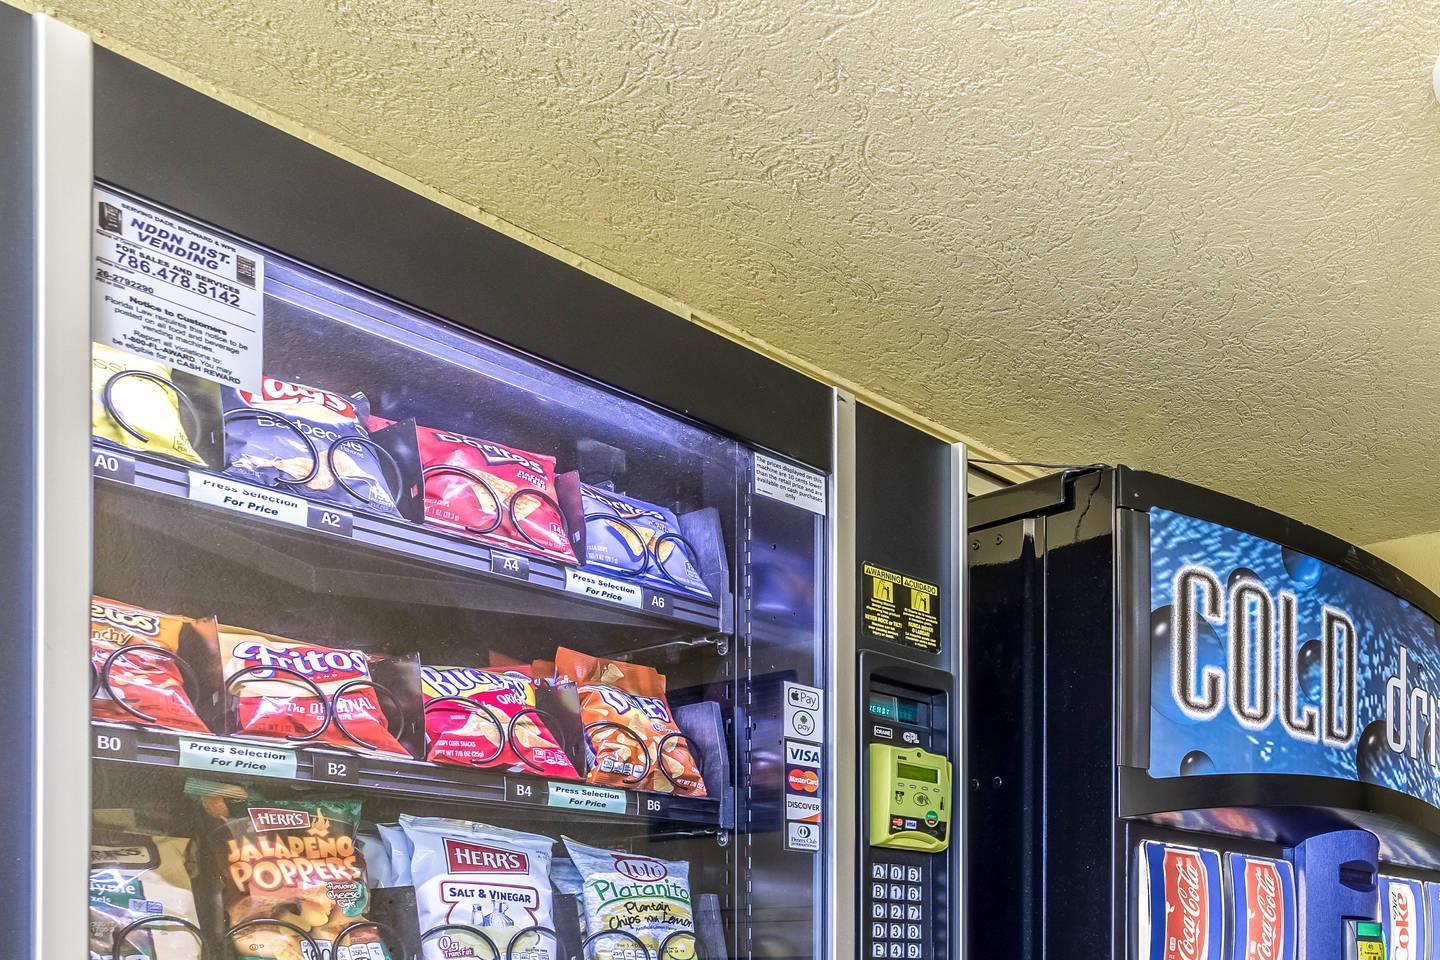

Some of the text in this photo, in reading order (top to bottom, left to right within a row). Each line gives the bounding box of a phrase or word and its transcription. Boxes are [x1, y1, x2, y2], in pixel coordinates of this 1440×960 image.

[130, 218, 184, 246] NDDN
[188, 241, 231, 265] DIST.
[138, 231, 218, 270] VENDING
[115, 243, 240, 294] FOR SALES AND SERVICES
[115, 250, 240, 307] 786.478.5142
[105, 295, 134, 311] Florida
[136, 307, 153, 316] Law
[155, 313, 188, 330] requires
[189, 325, 202, 335] this
[205, 331, 228, 345] notice
[130, 296, 227, 336] Notice to Customers
[176, 359, 241, 385] CASH REWARD
[200, 359, 214, 370] You
[94, 454, 119, 471] A0
[320, 512, 340, 528] A2
[503, 558, 519, 571] A4
[871, 567, 901, 584] WARNING
[572, 573, 635, 594] Press Selection
[908, 580, 936, 594] CUIDADO
[586, 586, 622, 601] For Price
[651, 596, 664, 608] A6
[233, 641, 369, 679] Fritos
[1172, 564, 1357, 748] COLD
[800, 692, 817, 707] Pay
[287, 704, 305, 714] The
[797, 723, 811, 732] pay
[97, 736, 121, 750] B0
[189, 742, 286, 761] Press Selection
[789, 747, 820, 764] VISA
[211, 757, 267, 771] For Price
[327, 763, 347, 777] B2
[789, 775, 819, 787] MasterCard
[516, 785, 531, 796] B4
[647, 800, 660, 811] B6
[788, 800, 820, 812] DISCOVER
[257, 812, 303, 827] HERR'S
[454, 848, 521, 869] HERR'S
[229, 857, 361, 892] POPPERS
[449, 887, 531, 904] SALT & VINEGAR
[624, 901, 671, 914] Plantain
[608, 916, 641, 930] Chips
[461, 948, 473, 956] Fat
